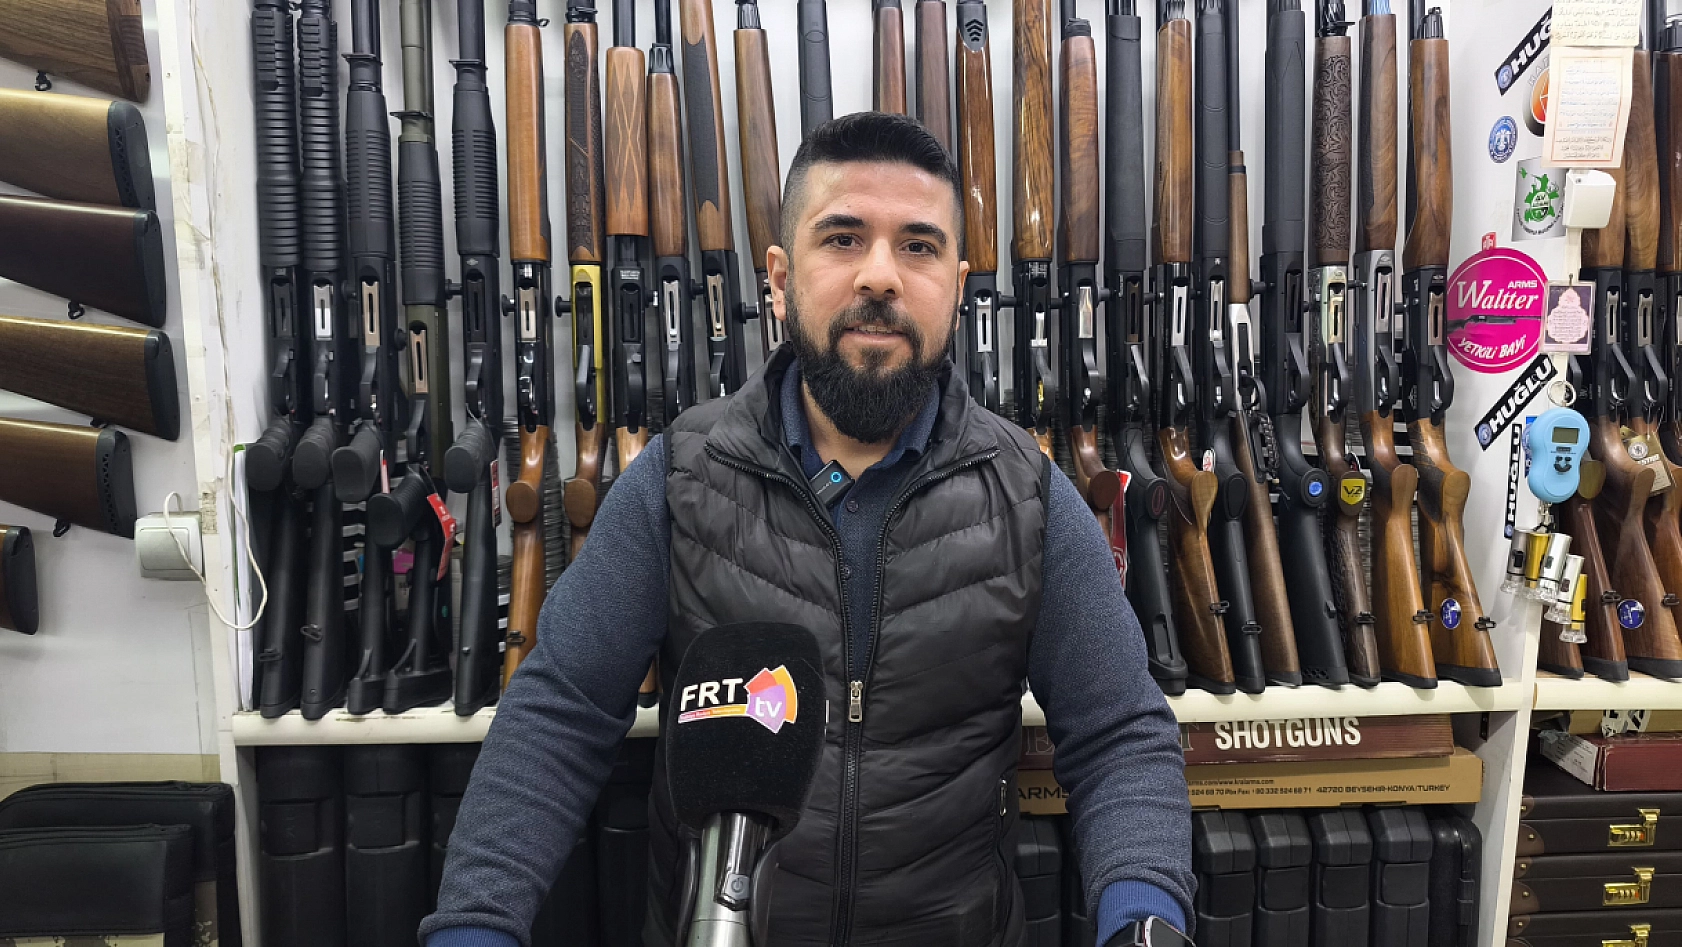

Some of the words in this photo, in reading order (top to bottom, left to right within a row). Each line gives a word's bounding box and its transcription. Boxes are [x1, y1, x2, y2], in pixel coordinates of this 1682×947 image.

[1511, 15, 1551, 75] HUĞ
[1457, 279, 1539, 310] Waltter
[1507, 280, 1538, 289] ARMS
[1489, 357, 1552, 433] HUĞLU
[680, 677, 744, 711] FRT
[755, 696, 783, 718] tv
[1215, 716, 1361, 749] SHOTGUNS
